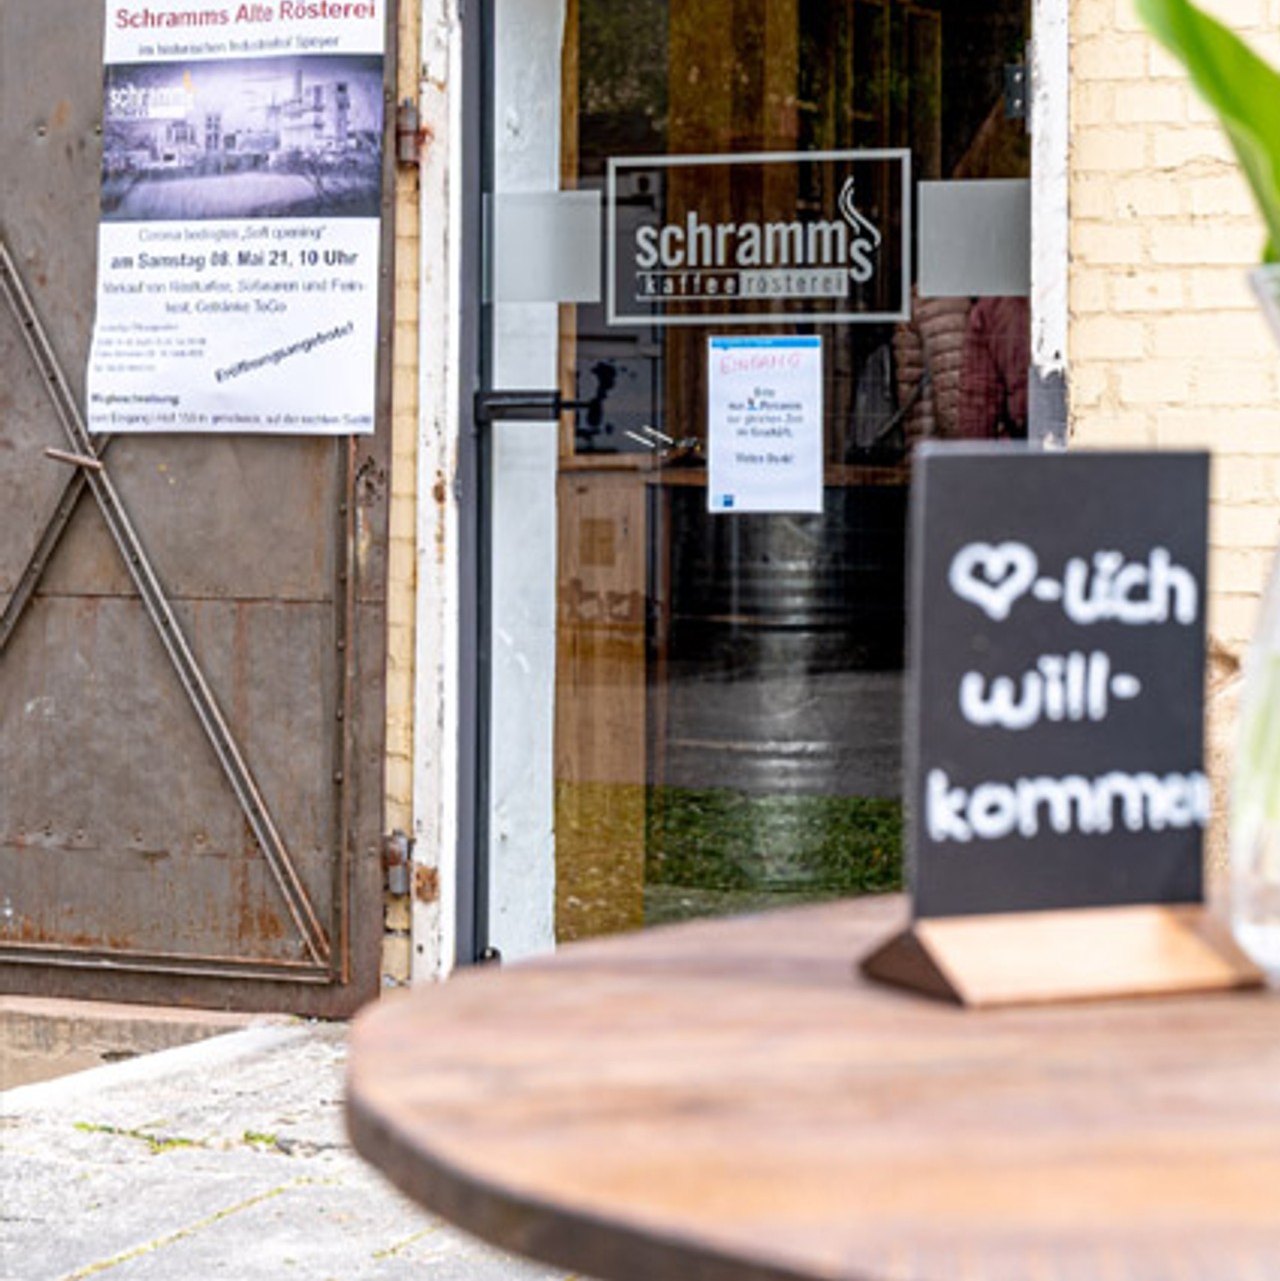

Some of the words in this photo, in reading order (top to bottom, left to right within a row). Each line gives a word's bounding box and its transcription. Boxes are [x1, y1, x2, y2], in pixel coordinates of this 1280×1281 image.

[115, 6, 231, 30] Schramms
[235, 2, 274, 24] Alte
[110, 255, 134, 270] am
[138, 251, 206, 272] Samstag
[210, 250, 232, 268] 08.
[237, 250, 264, 267] Mai
[299, 249, 319, 266] 10
[323, 248, 359, 267] Uhr
[635, 210, 874, 282] schramms
